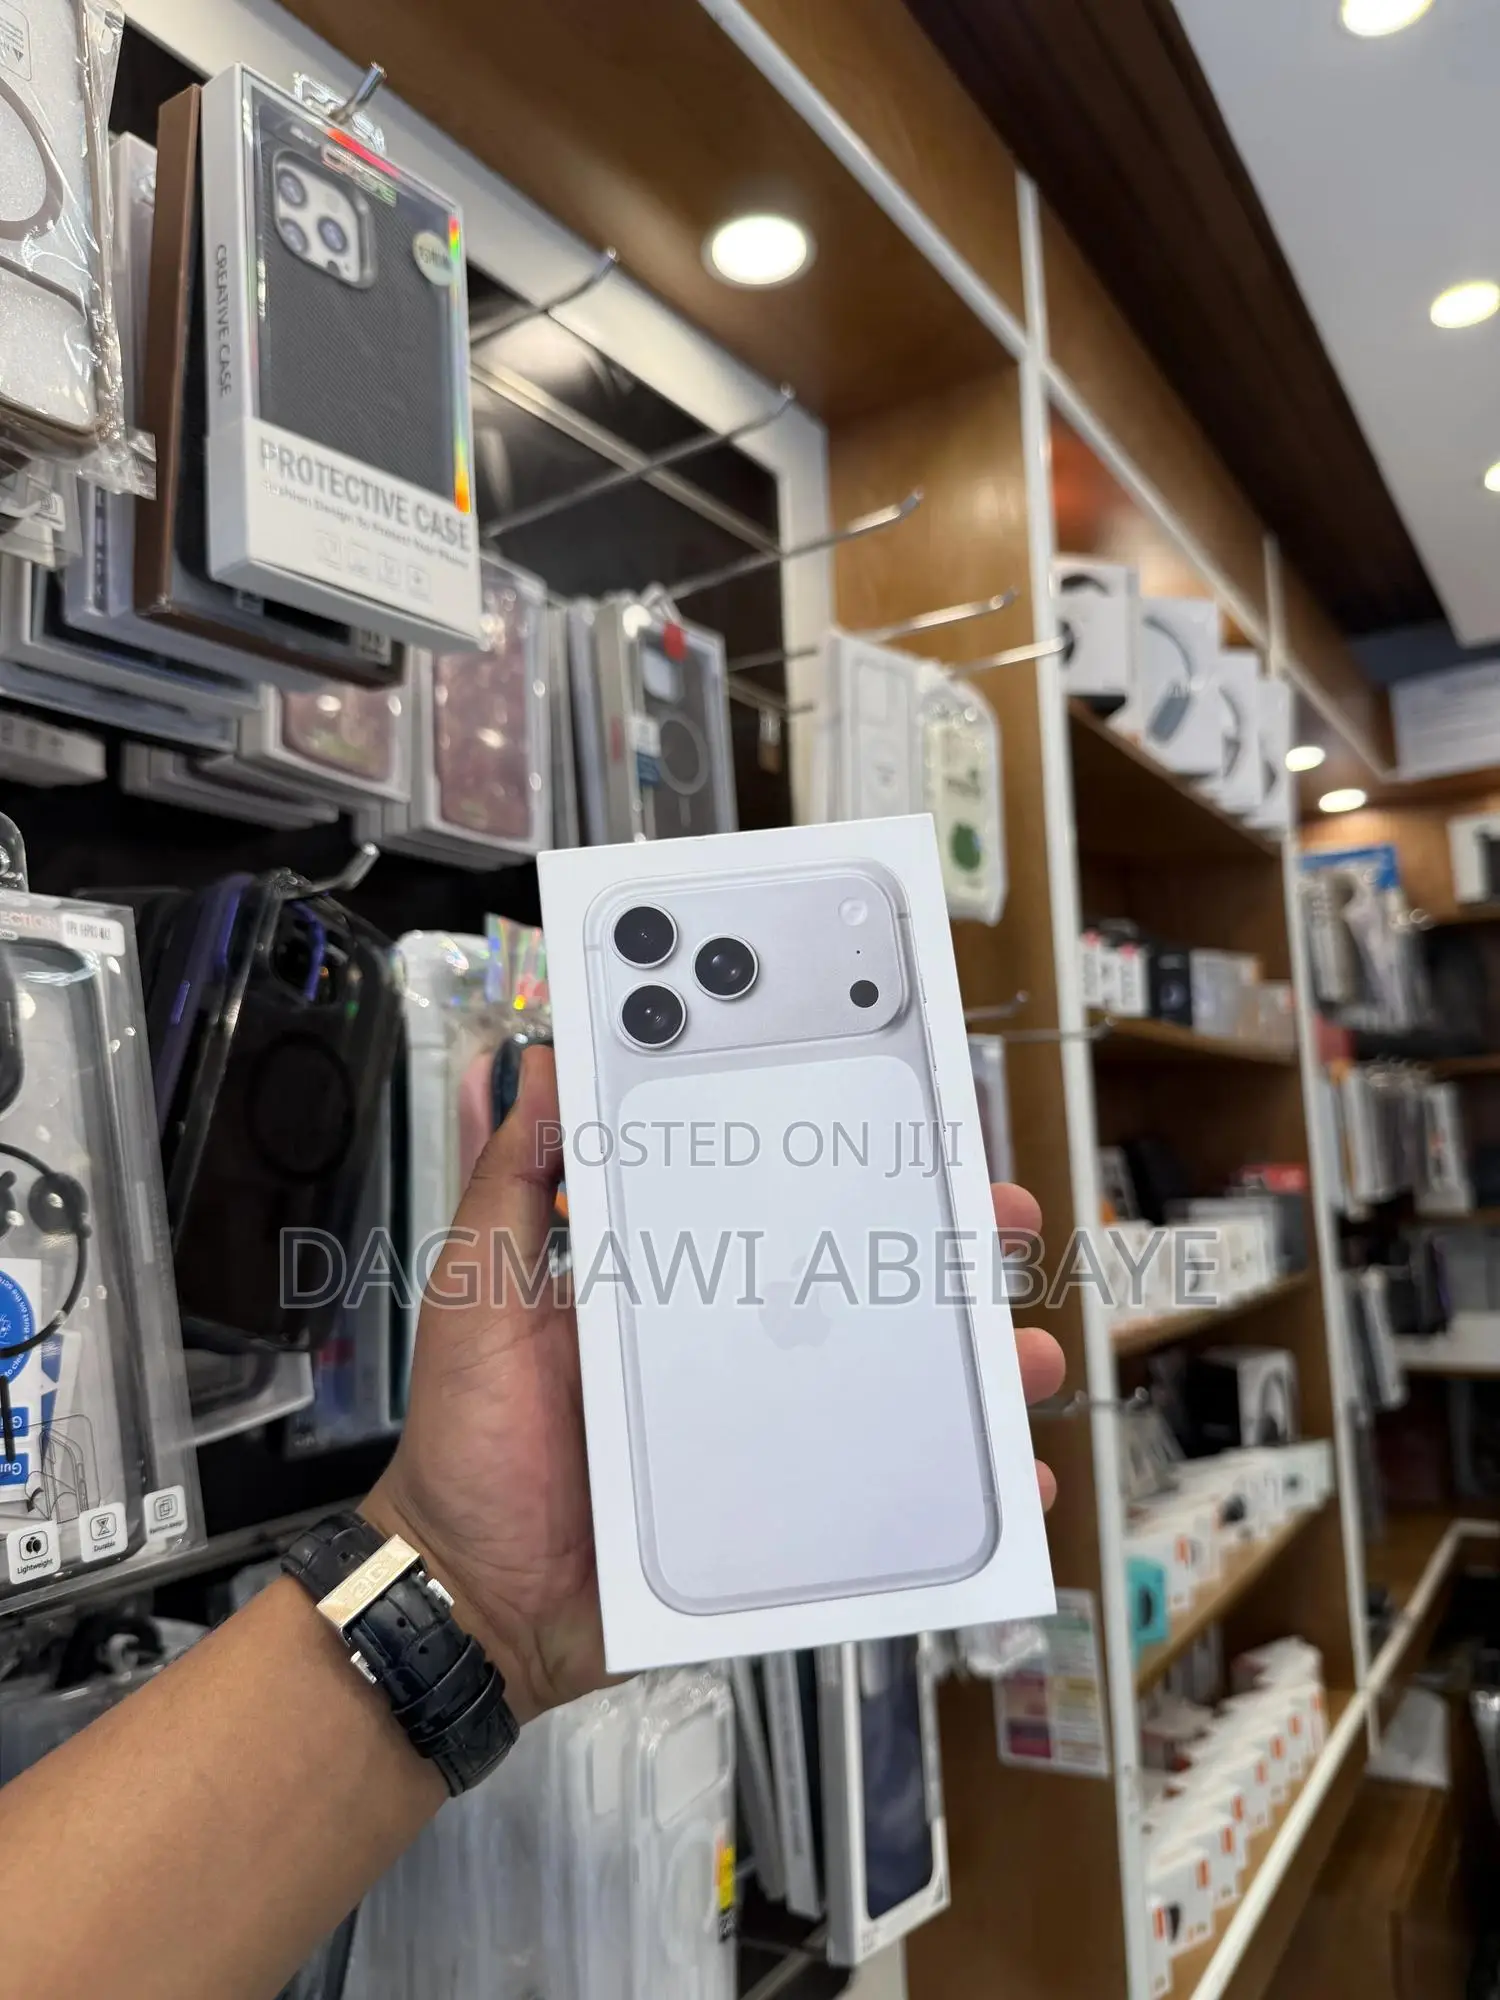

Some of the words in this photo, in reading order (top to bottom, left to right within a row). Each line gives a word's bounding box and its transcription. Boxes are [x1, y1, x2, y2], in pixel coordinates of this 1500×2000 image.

[215, 243, 230, 341] CREATIVE
[218, 344, 232, 398] CASE
[260, 436, 410, 528] PROTECTIVE
[415, 501, 472, 550] CASE
[11, 1288, 23, 1303] the
[20, 1301, 28, 1313] on
[22, 1314, 31, 1334] dust
[12, 1353, 25, 1371] clea
[4, 1368, 13, 1377] to
[16, 1558, 54, 1575] Lightweight
